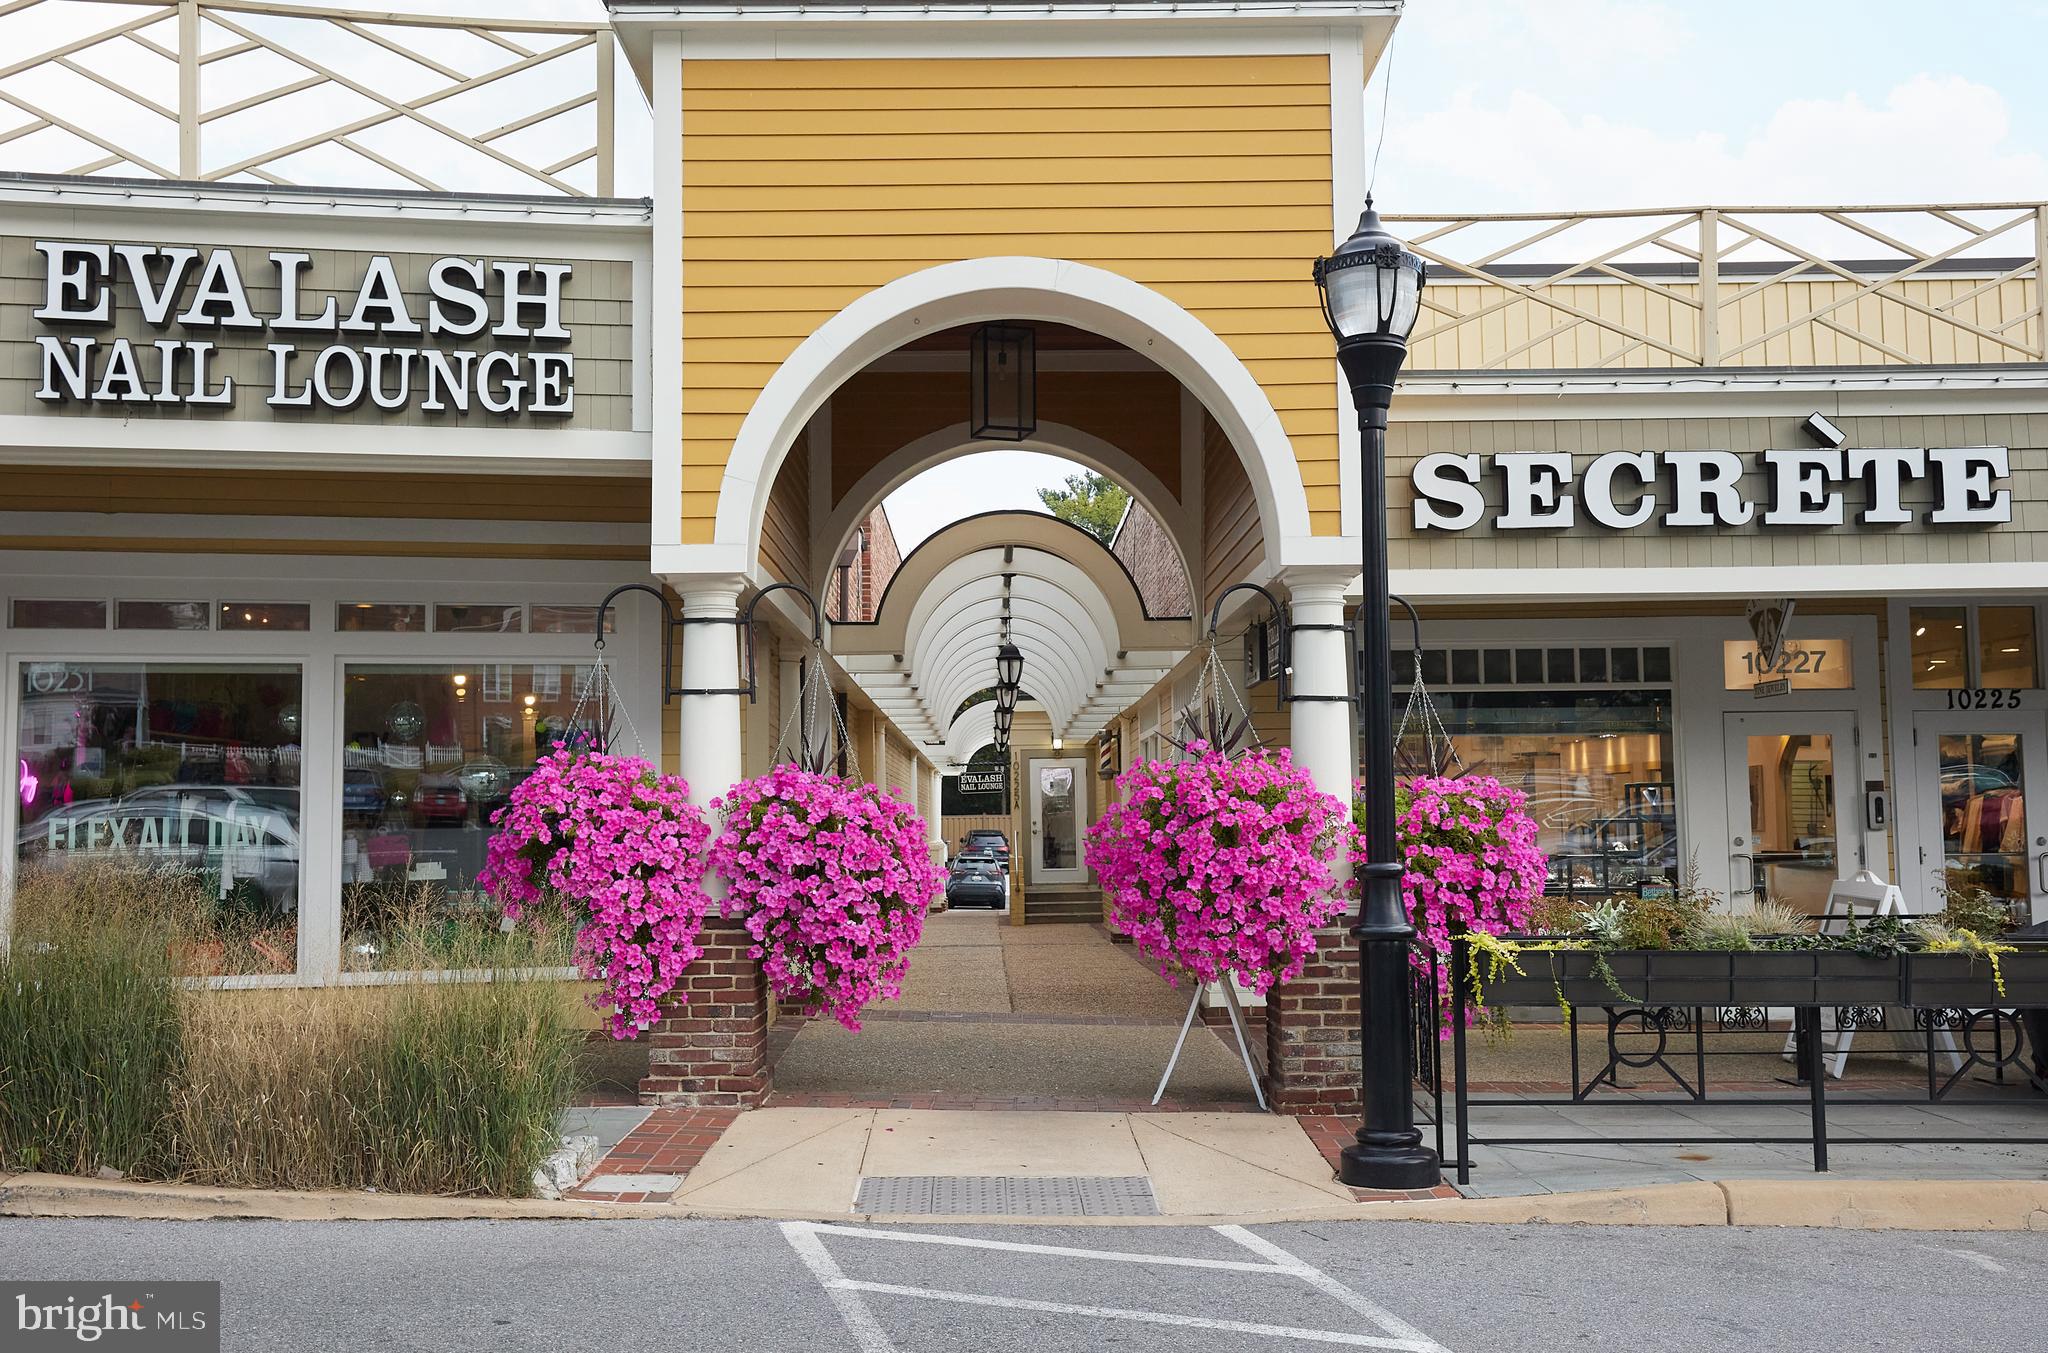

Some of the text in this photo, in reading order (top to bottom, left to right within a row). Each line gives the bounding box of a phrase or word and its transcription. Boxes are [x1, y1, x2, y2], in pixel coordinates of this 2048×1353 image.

[33, 240, 575, 342] EVALASH
[34, 335, 575, 416] NAIL LOUNGE
[1409, 411, 2013, 530] SECRÈTE
[1742, 650, 1827, 675] 10227
[1947, 688, 2022, 710] 10225
[960, 782, 1004, 791] NAIL LOUNGE
